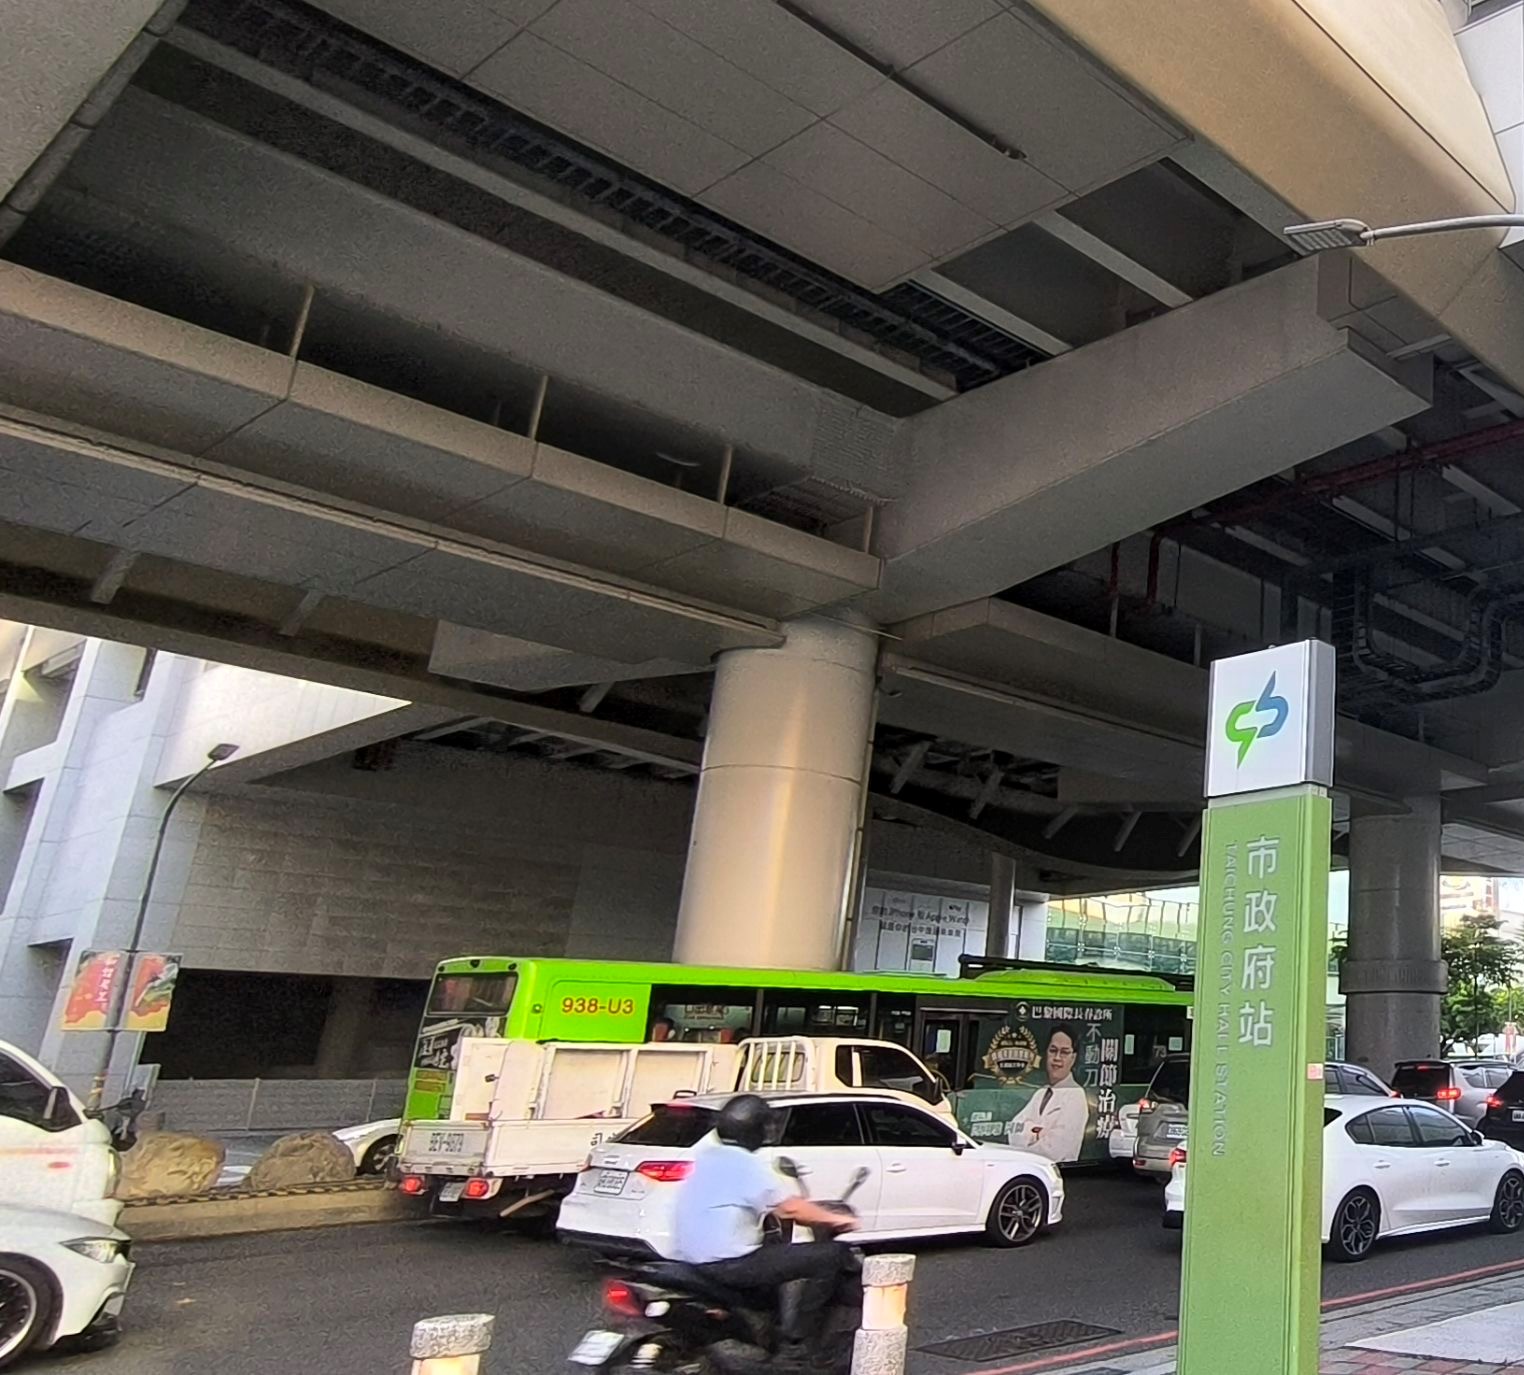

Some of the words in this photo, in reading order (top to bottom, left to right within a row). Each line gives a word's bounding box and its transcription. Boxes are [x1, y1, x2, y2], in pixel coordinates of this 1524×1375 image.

[1221, 841, 1238, 945] TAICHUNG
[1218, 950, 1233, 997] CITY
[1238, 836, 1280, 1047] 市政府站
[562, 997, 634, 1014] 938-U3
[1215, 1003, 1231, 1052] HALL
[1083, 1022, 1101, 1088] 不動刀
[1096, 1038, 1120, 1139] 關節治療
[1212, 1062, 1229, 1157] STATION
